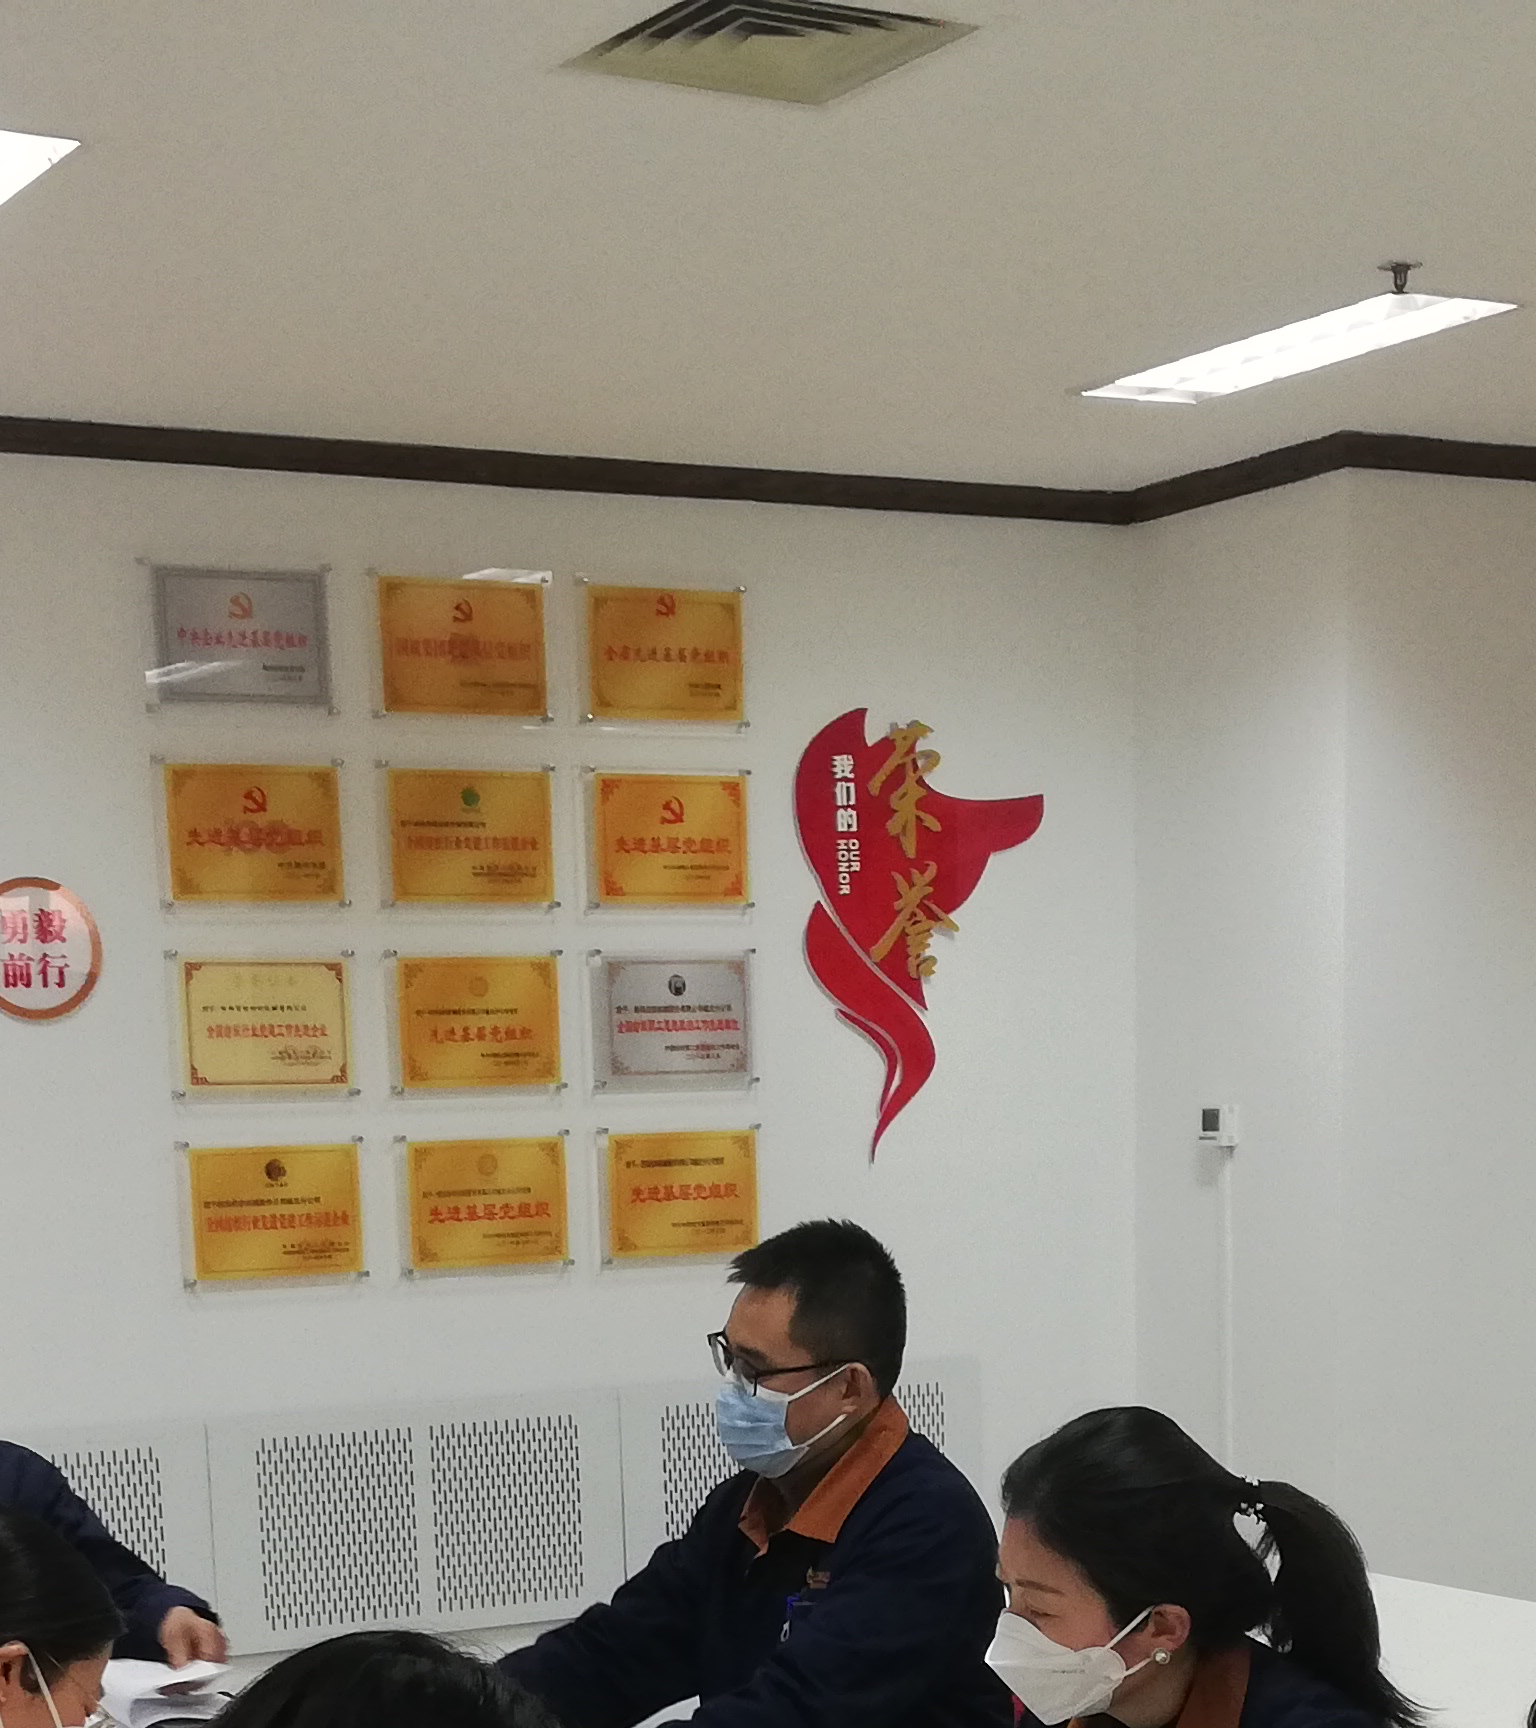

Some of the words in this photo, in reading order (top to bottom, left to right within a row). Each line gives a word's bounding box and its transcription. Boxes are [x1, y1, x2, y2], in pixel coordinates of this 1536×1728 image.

[831, 754, 858, 832] 我们的
[836, 839, 851, 896] HONOR
[849, 839, 861, 873] OUR
[867, 720, 960, 979] 荣誉
[0, 908, 68, 945] 勇毅
[0, 952, 70, 990] 前行
